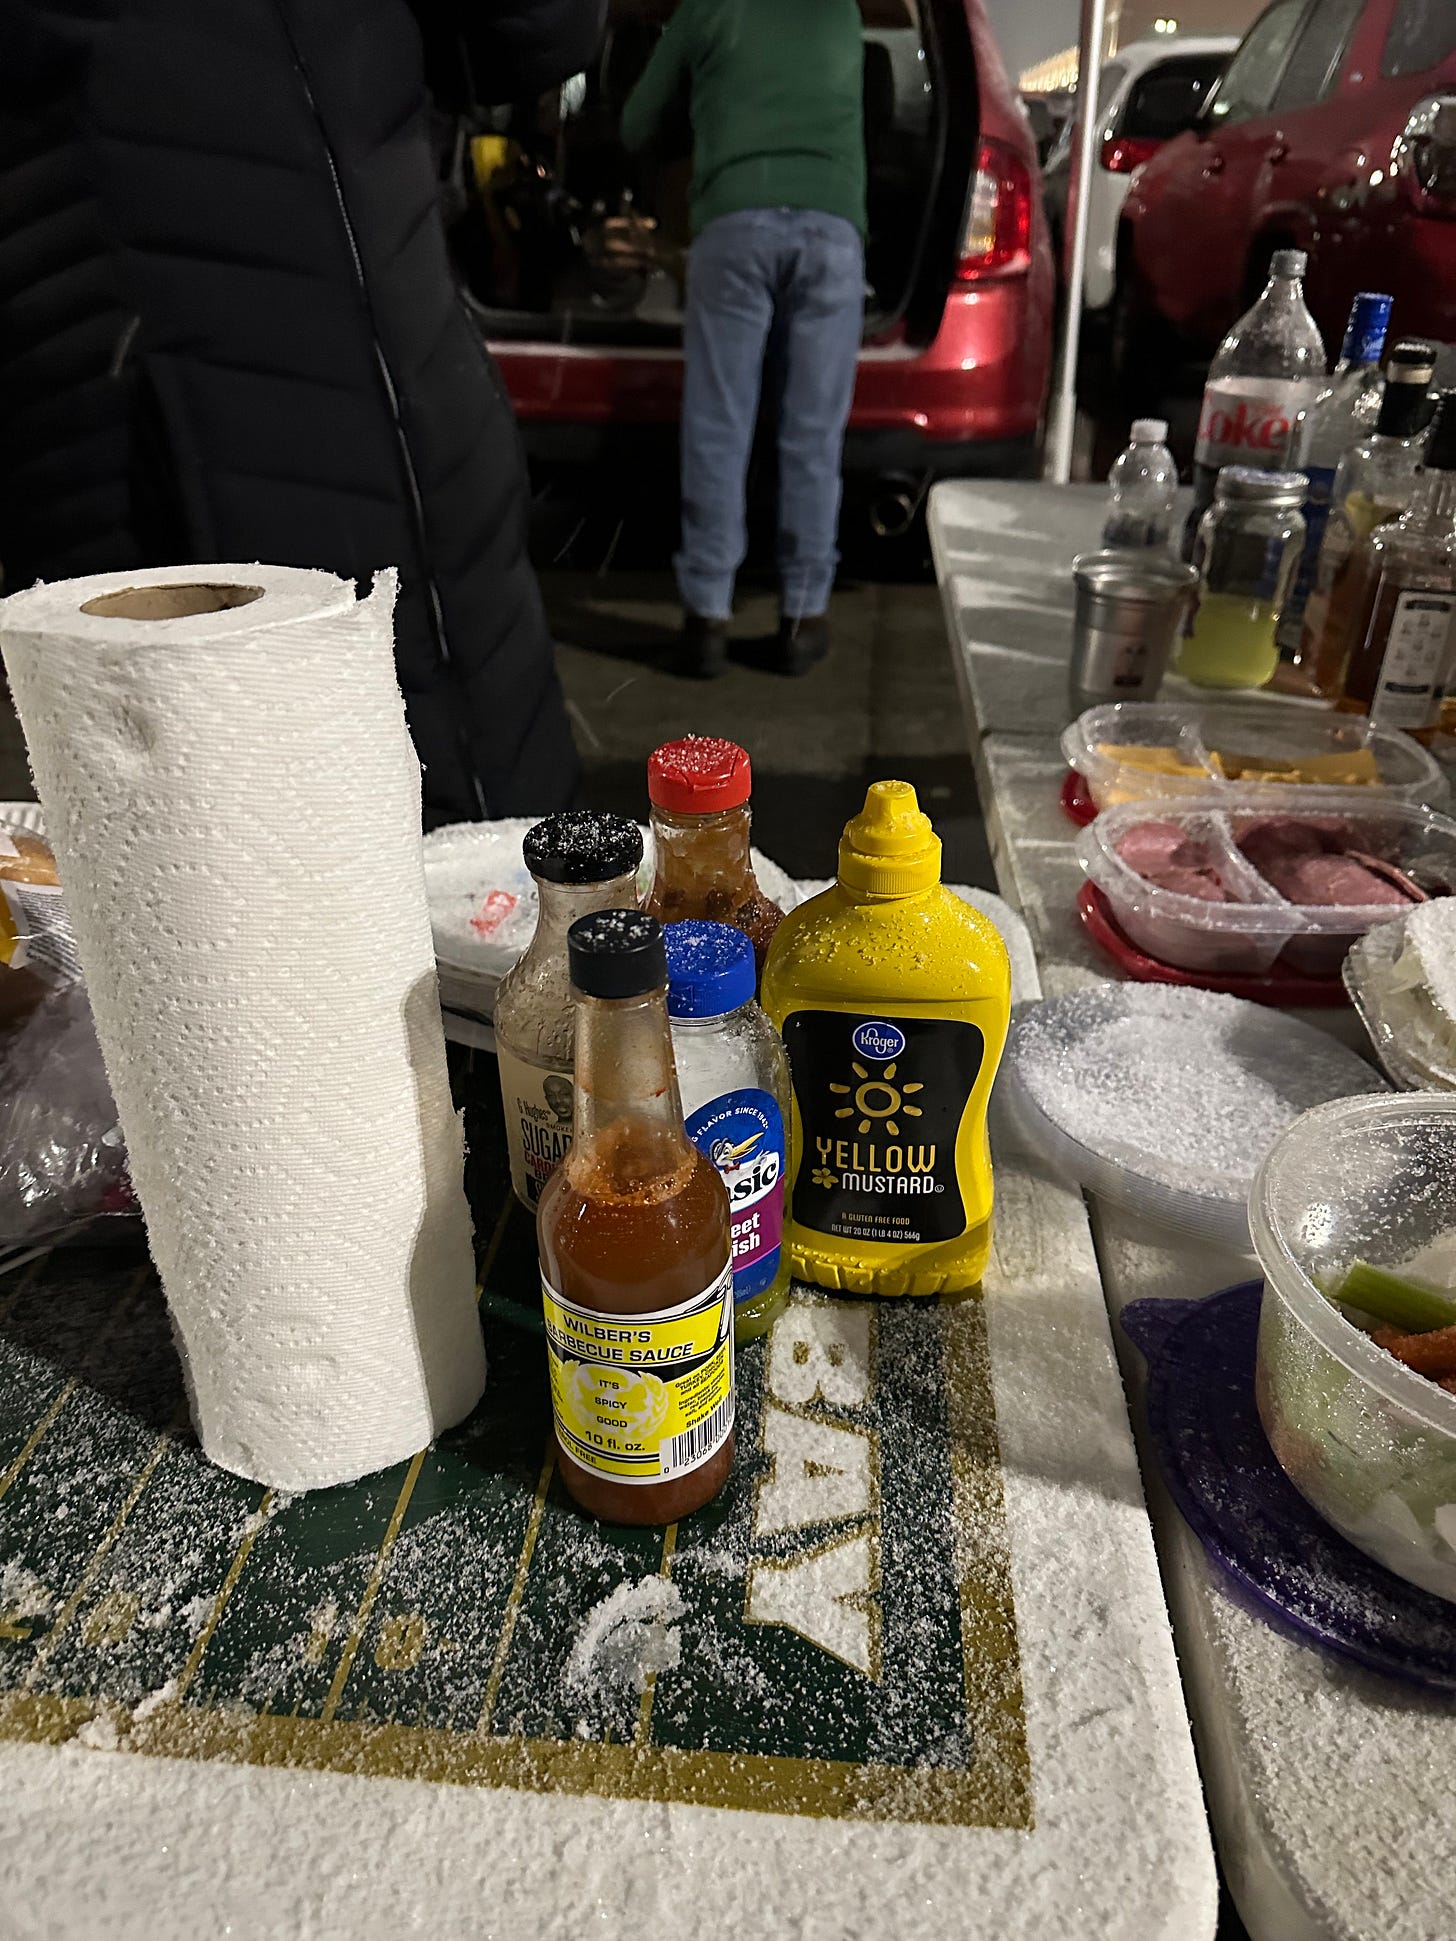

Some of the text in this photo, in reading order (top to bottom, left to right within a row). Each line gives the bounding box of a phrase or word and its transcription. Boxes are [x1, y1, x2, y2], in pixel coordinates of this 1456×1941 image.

[861, 1028, 899, 1054] Kroger
[696, 1110, 732, 1136] FLAVOR
[734, 1106, 758, 1116] SINCE
[816, 1136, 936, 1173] YELLOW
[842, 1172, 934, 1194] MUSTARD
[730, 1212, 761, 1239] eet
[841, 1211, 910, 1226] A GLUTEN FREE FOOD
[831, 1223, 842, 1232] NET
[842, 1225, 852, 1234] WT
[853, 1227, 862, 1236] 20
[862, 1228, 871, 1236] OZ
[878, 1229, 886, 1238] LB
[886, 1230, 892, 1238] 4
[892, 1230, 903, 1240] OZ)
[904, 1231, 921, 1242] 566g
[563, 1314, 651, 1343] WILBER'S
[547, 1318, 623, 1361] BARBECUE
[629, 1342, 694, 1362] SAUCE
[599, 1379, 620, 1390] IT'S
[594, 1396, 627, 1410] SPICY
[596, 1415, 628, 1428] GOOD
[686, 1410, 709, 1428] Shake
[585, 1430, 604, 1446] 10
[607, 1438, 621, 1450] fl.
[625, 1441, 646, 1451] oz.
[574, 1446, 597, 1465] FREE
[743, 1300, 882, 1684] BAY
